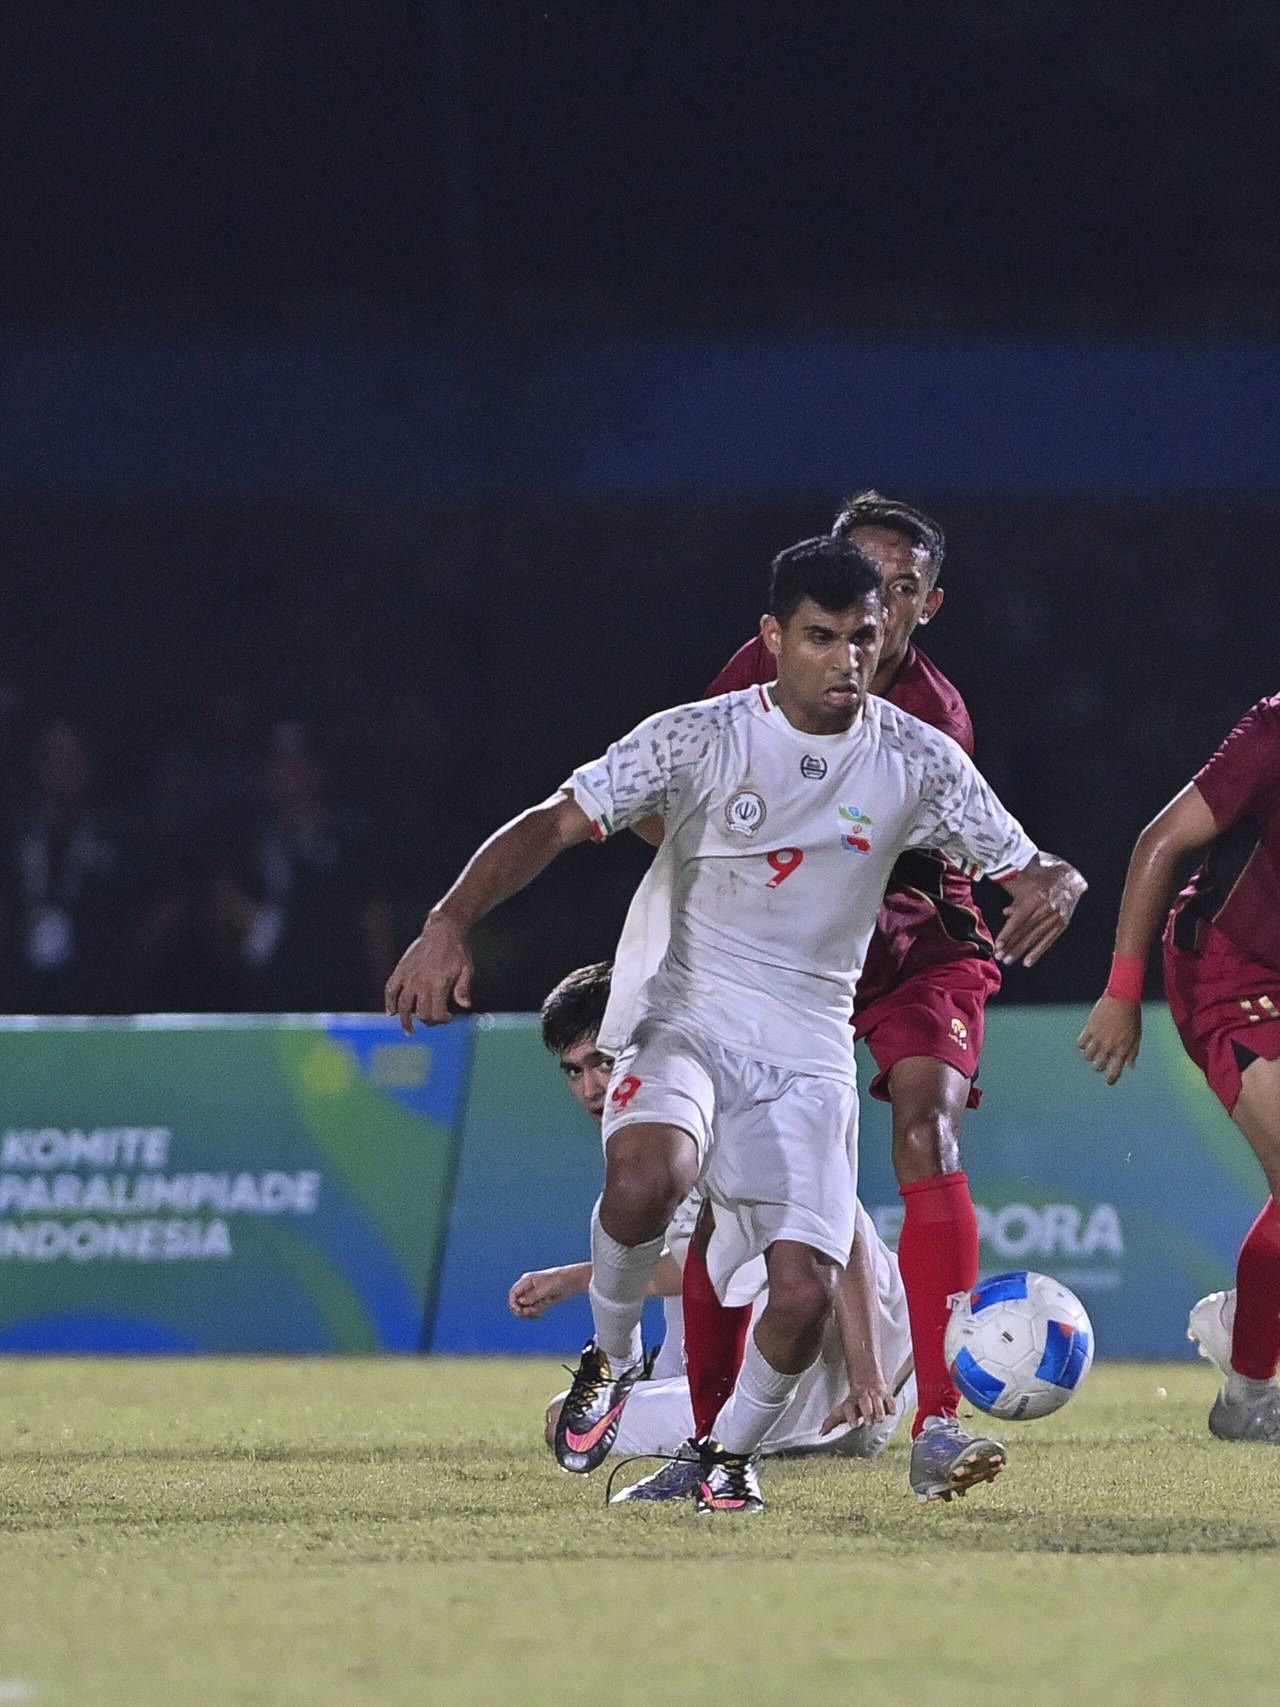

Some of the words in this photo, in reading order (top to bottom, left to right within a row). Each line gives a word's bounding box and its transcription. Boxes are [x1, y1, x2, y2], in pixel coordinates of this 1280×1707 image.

[765, 846, 805, 889] 9
[611, 1075, 643, 1115] 9
[3, 1128, 171, 1167] KOMITE
[0, 1171, 320, 1213] PARALIMPIADE
